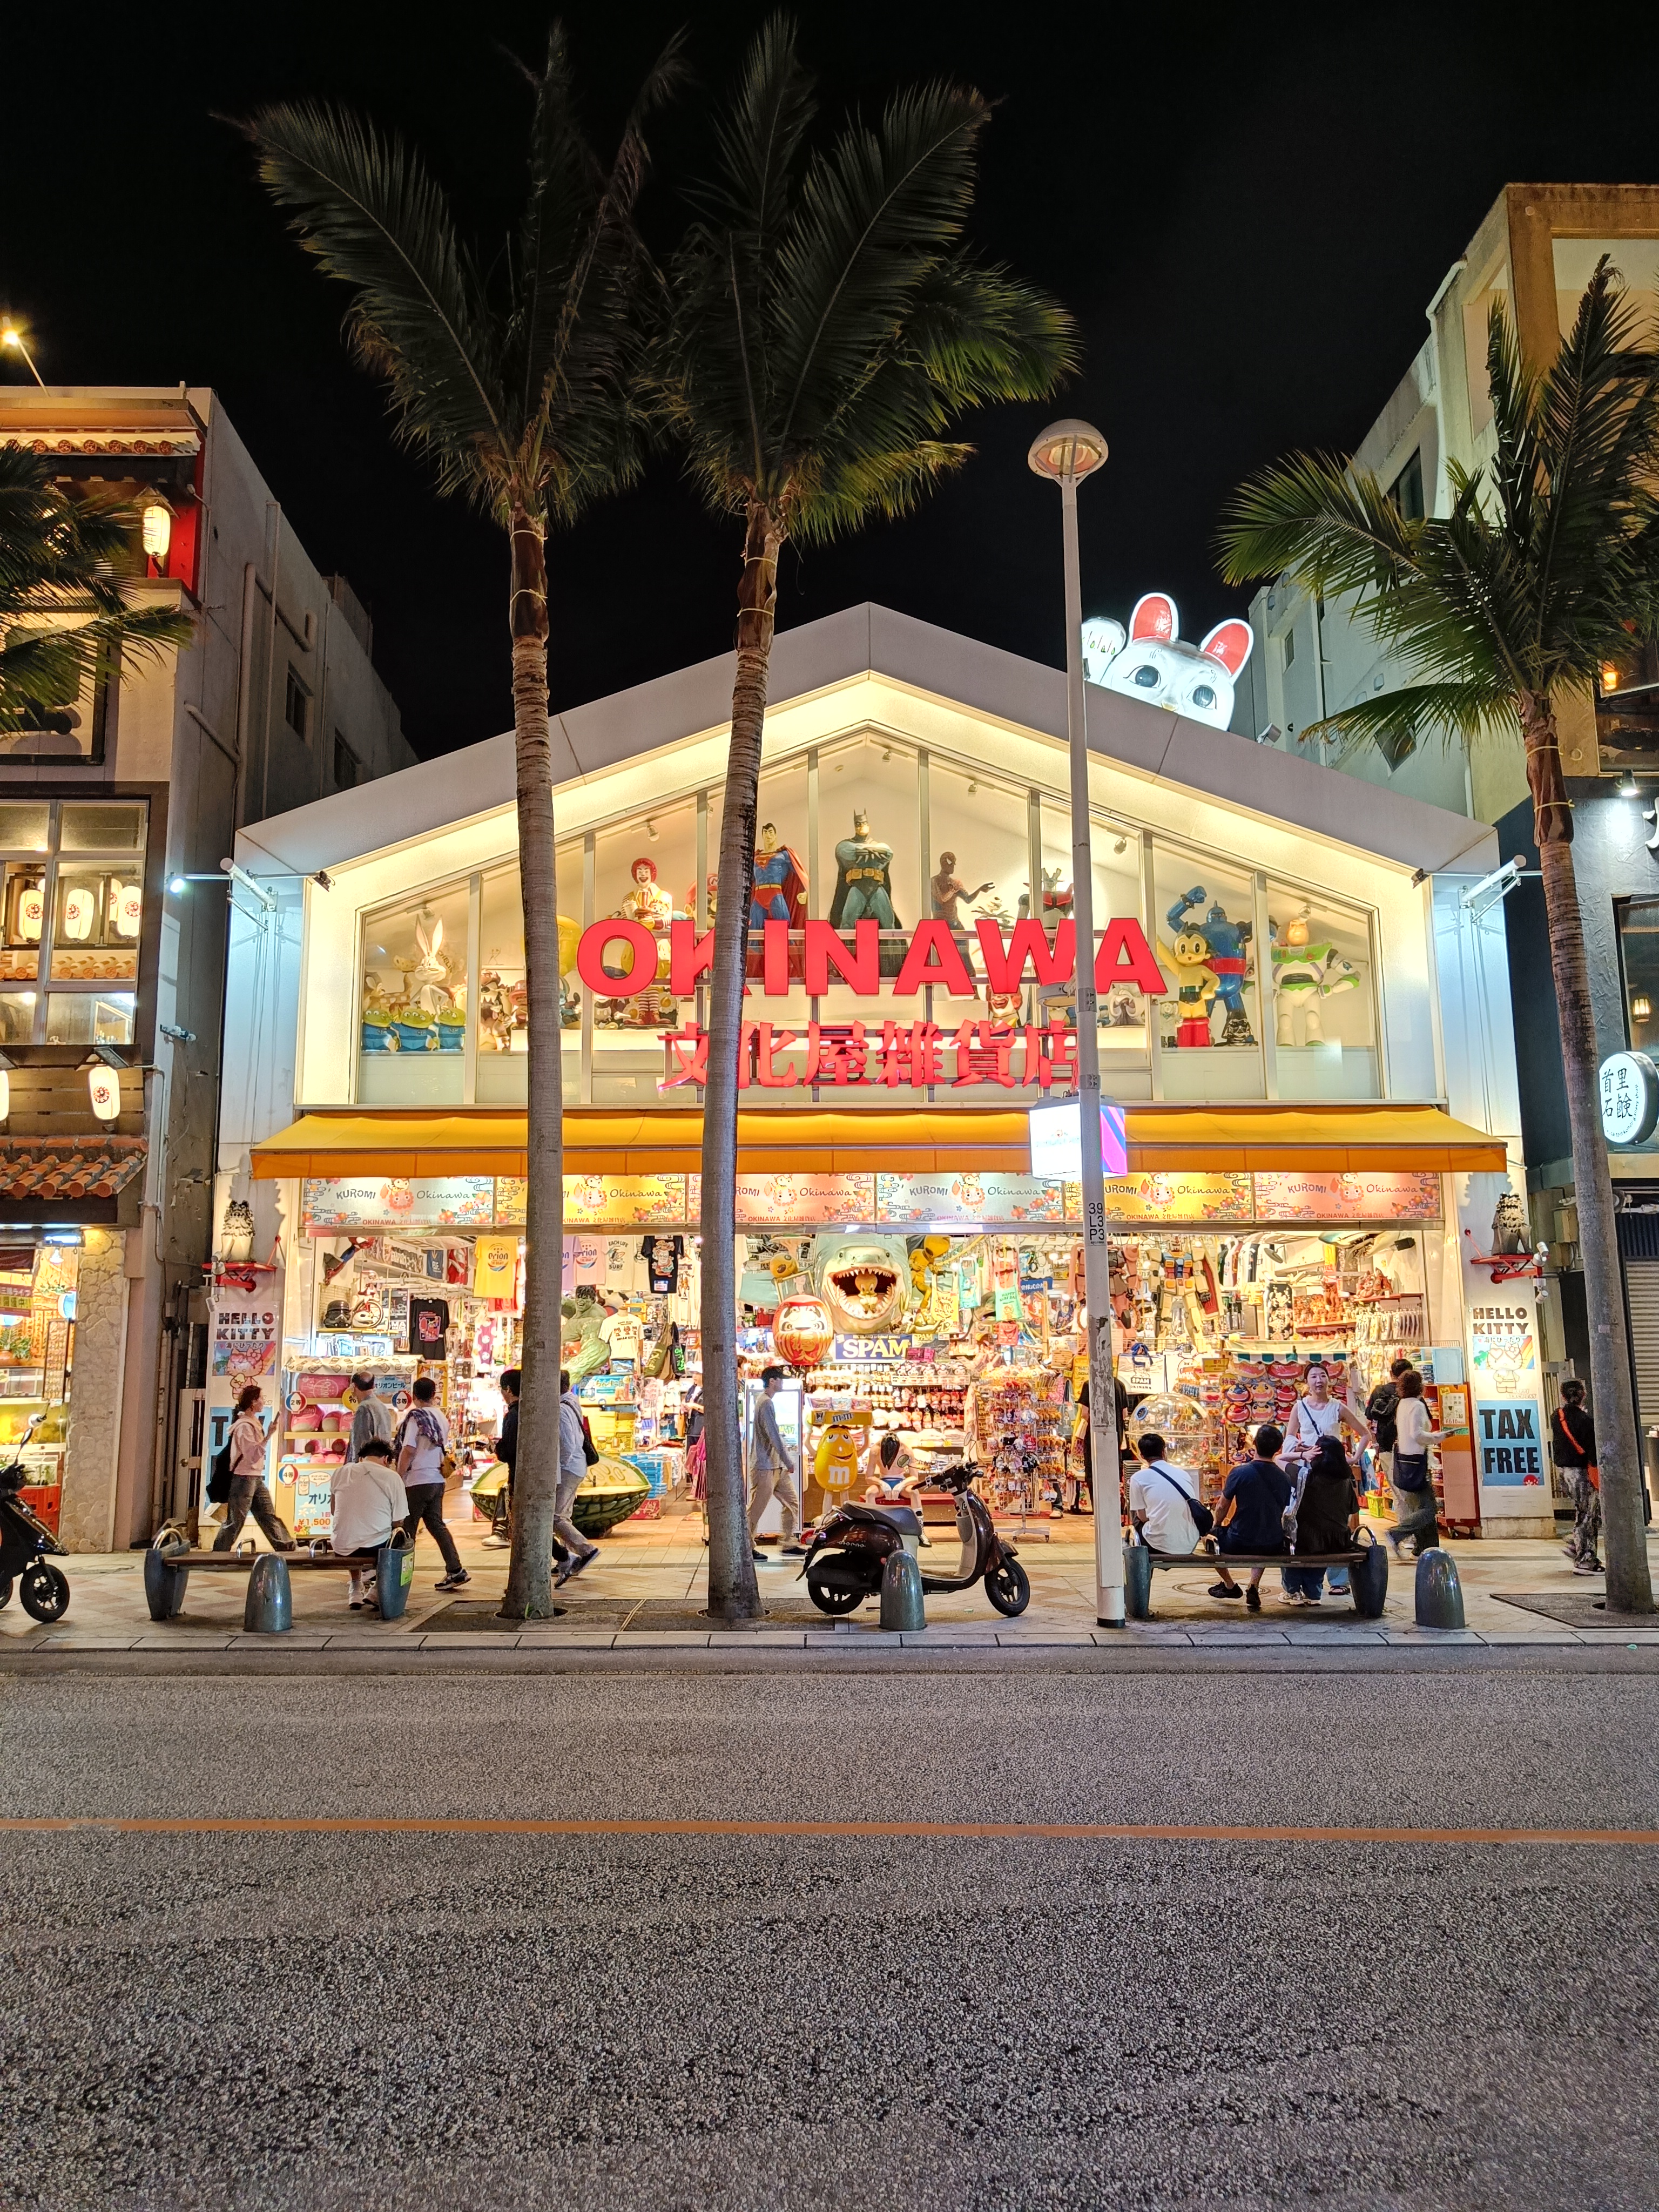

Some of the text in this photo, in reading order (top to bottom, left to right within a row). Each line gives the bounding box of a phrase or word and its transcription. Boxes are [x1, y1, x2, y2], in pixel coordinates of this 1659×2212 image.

[577, 918, 1168, 996] OKINAWA
[610, 1189, 662, 1197] Okinawa
[736, 1186, 852, 1196] ROMI Okinawa
[909, 1186, 1040, 1196] KUROMI Okinawa
[1104, 1184, 1230, 1195] UROMI Okinawa
[1288, 1183, 1418, 1193] KUROMI Okinawa
[336, 1189, 470, 1199] KUROMI Okinawa
[1089, 1203, 1103, 1214] 39
[1089, 1216, 1103, 1227] L3
[1090, 1229, 1104, 1240] P3
[218, 1312, 274, 1324] HELLO
[1473, 1307, 1527, 1319] HELLO
[217, 1328, 275, 1339] KITTY
[1473, 1323, 1529, 1334] KITTY
[842, 1339, 909, 1358] SPAM
[1479, 1409, 1535, 1439] TAX
[1483, 1447, 1540, 1473] FREE
[828, 1465, 849, 1484] m
